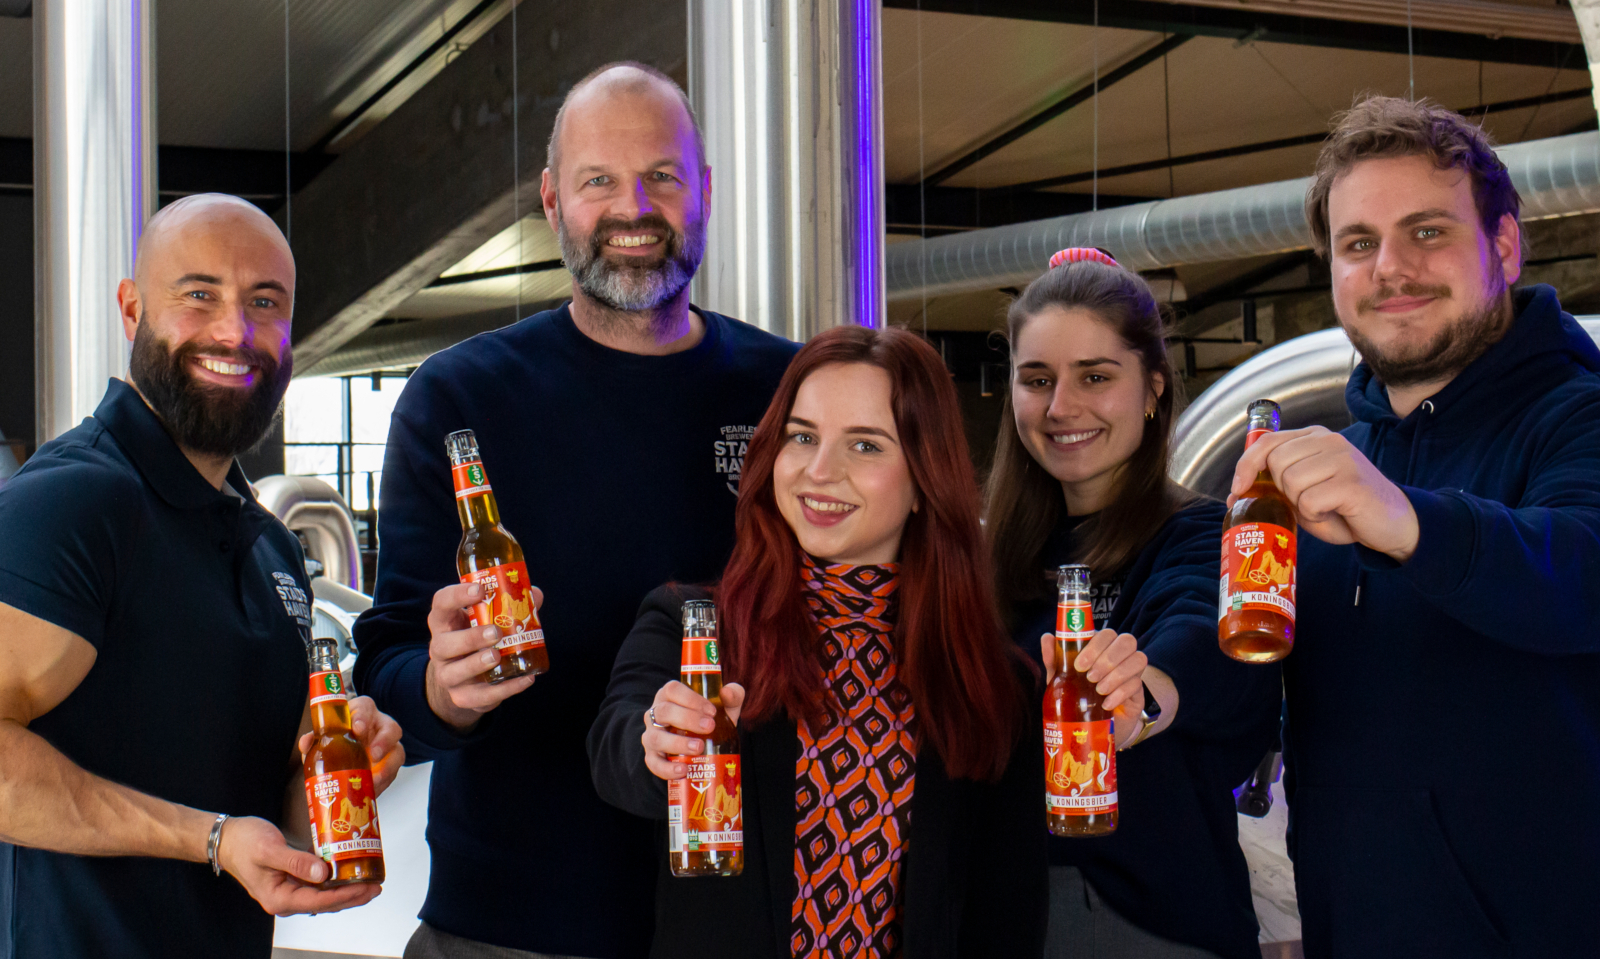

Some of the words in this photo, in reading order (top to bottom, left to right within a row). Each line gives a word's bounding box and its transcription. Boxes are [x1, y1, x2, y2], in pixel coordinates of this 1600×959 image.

[720, 425, 757, 435] FEARLE
[714, 440, 748, 456] STA
[1235, 531, 1265, 541] STADS
[1234, 538, 1265, 547] HAVEN
[472, 575, 497, 586] TADS
[276, 585, 308, 604] STADS
[1089, 583, 1121, 597] STA
[1044, 729, 1063, 738] STADS
[686, 771, 716, 779] HAVEN
[314, 779, 339, 792] STADS
[315, 786, 340, 798] HAVEN
[1056, 796, 1108, 806] KONINGSBIER
